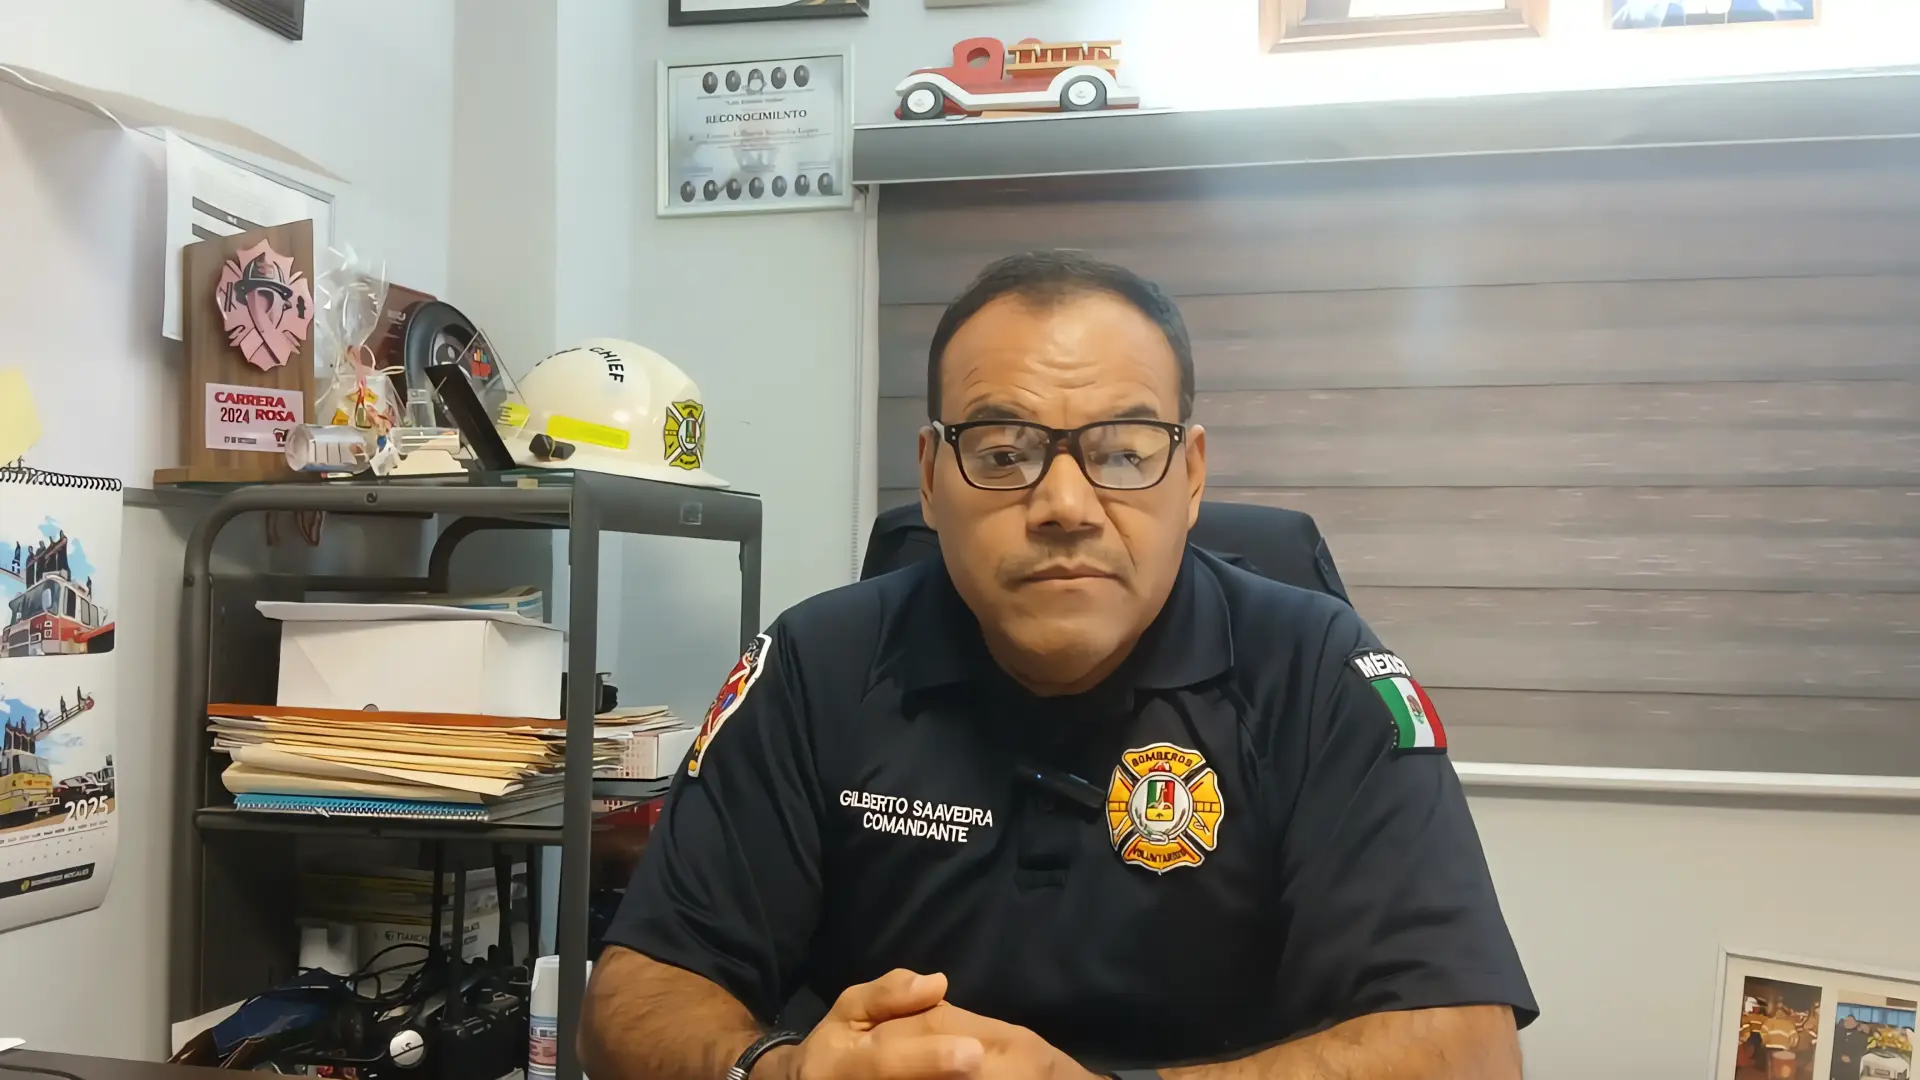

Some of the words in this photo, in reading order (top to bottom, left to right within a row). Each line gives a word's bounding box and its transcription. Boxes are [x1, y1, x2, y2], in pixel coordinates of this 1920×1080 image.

[589, 347, 624, 383] CHIEF
[214, 391, 286, 409] CARRERA
[220, 407, 250, 424] 2024
[255, 408, 296, 422] ROSA
[1131, 751, 1193, 767] BOMBEROS
[64, 795, 109, 824] 2025
[840, 790, 908, 814] GILBERTO
[912, 800, 993, 827] SAAVEDRA
[863, 811, 969, 843] COMANDANTE
